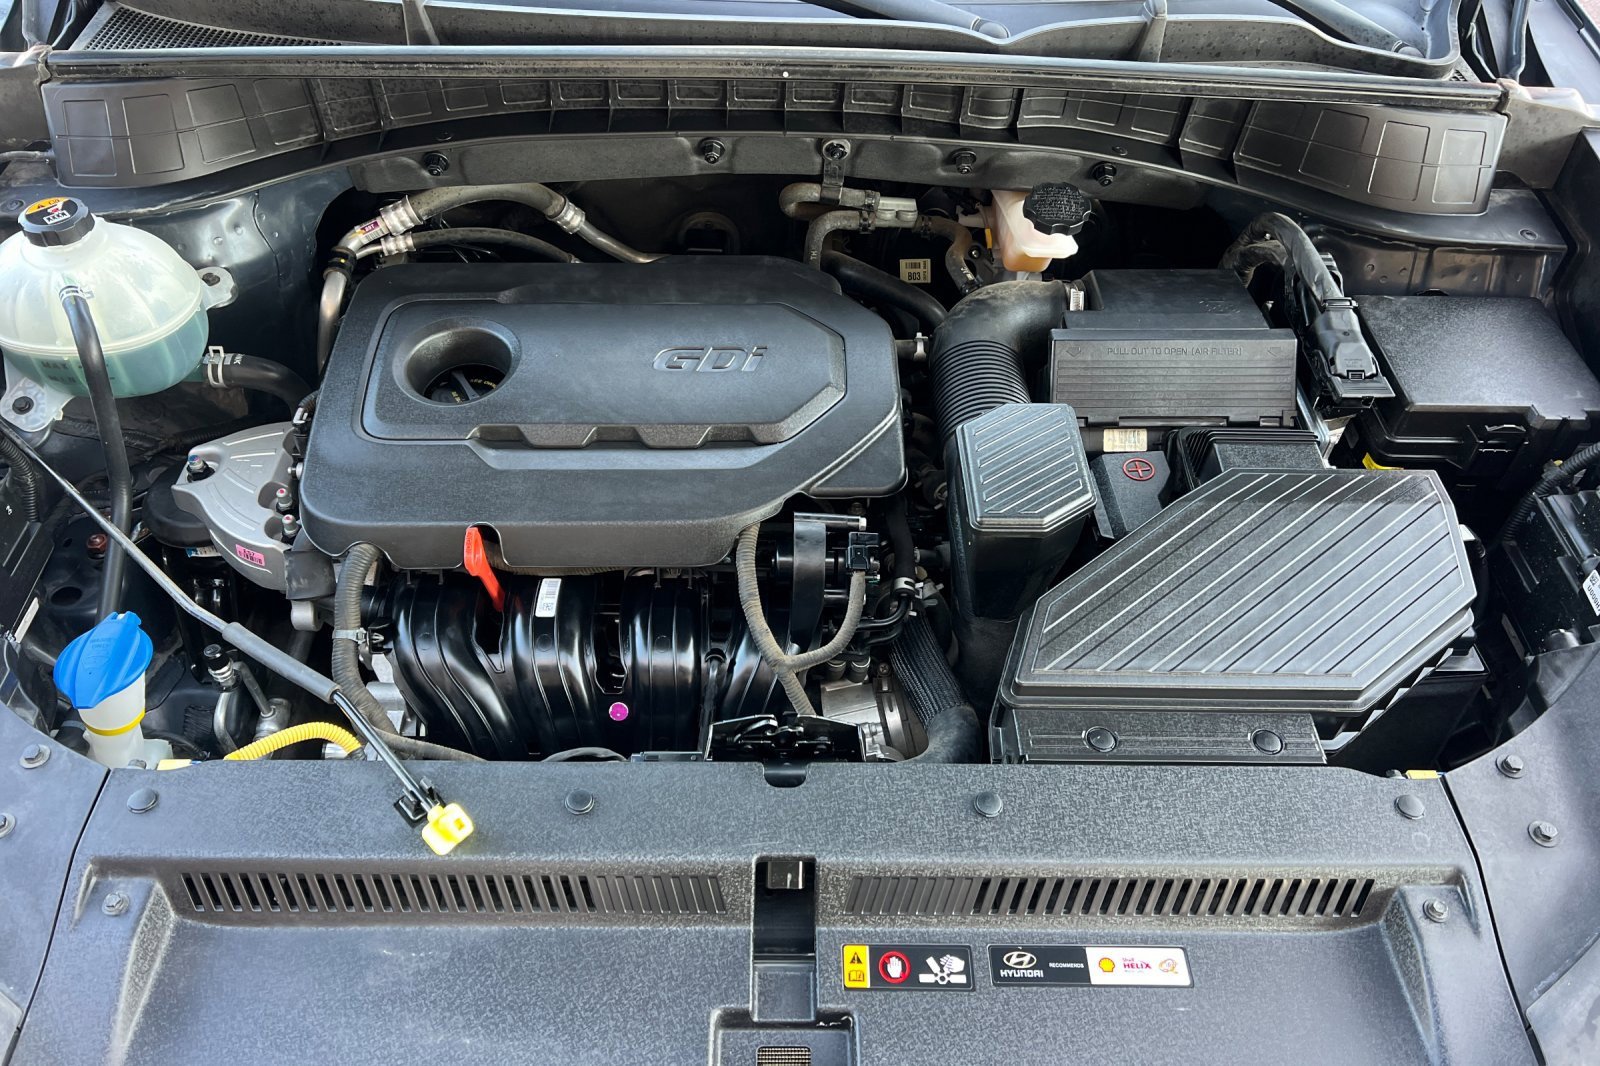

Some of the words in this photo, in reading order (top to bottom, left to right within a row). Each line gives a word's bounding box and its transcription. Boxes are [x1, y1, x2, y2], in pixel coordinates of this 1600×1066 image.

[907, 272, 921, 280] B03
[1107, 347, 1129, 355] PULL
[1131, 347, 1149, 355] OUT
[1152, 347, 1162, 355] TO
[1164, 347, 1188, 355] OPEN
[1191, 347, 1209, 356] (AIR
[1211, 347, 1242, 356] FILTER)
[652, 346, 768, 372] GDi
[1123, 961, 1152, 970] HELIX
[1000, 969, 1044, 978] HYUNDAI
